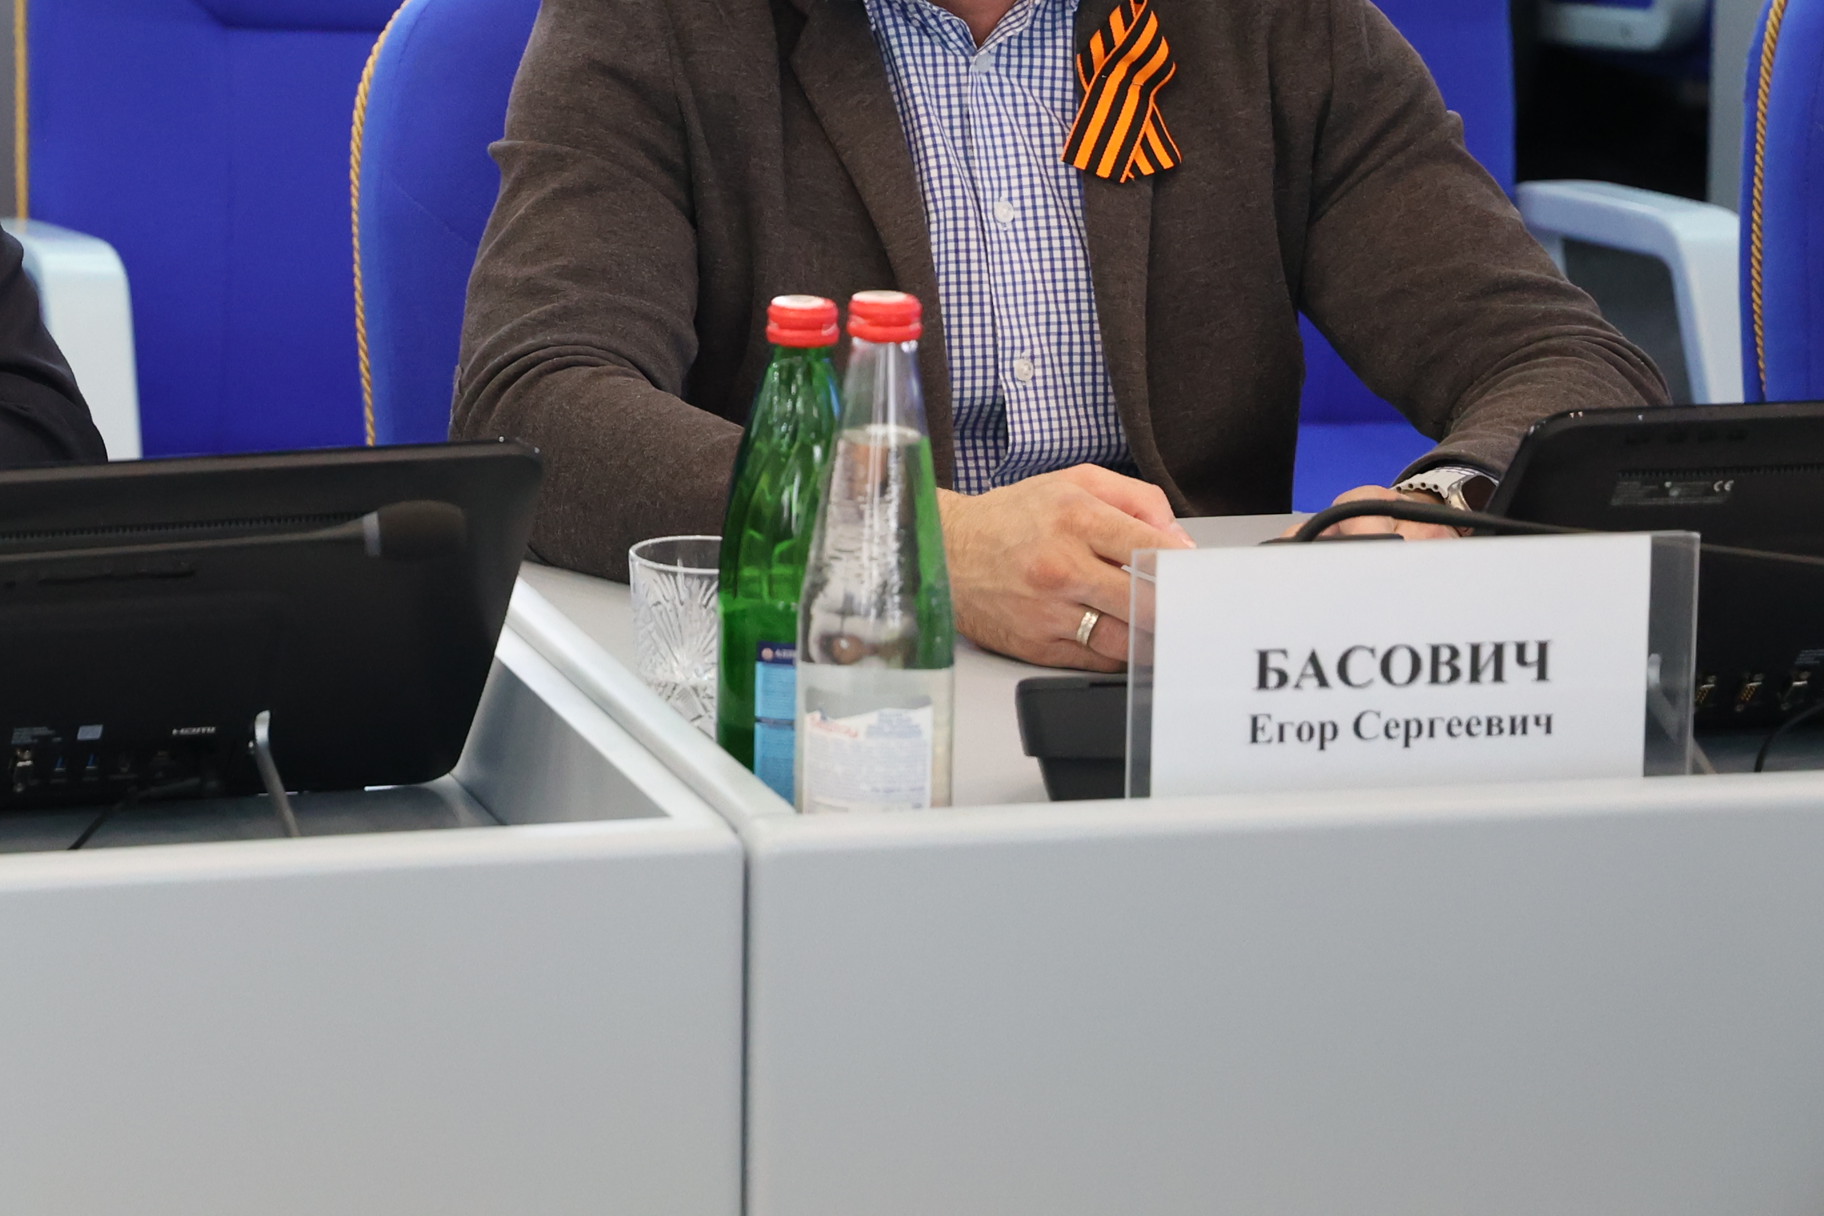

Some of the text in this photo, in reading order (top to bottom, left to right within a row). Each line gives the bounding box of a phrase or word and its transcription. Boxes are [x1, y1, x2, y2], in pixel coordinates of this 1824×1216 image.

[1255, 639, 1551, 691] БАСОВИЧ
[1249, 710, 1554, 752] Егор Сергеевич
